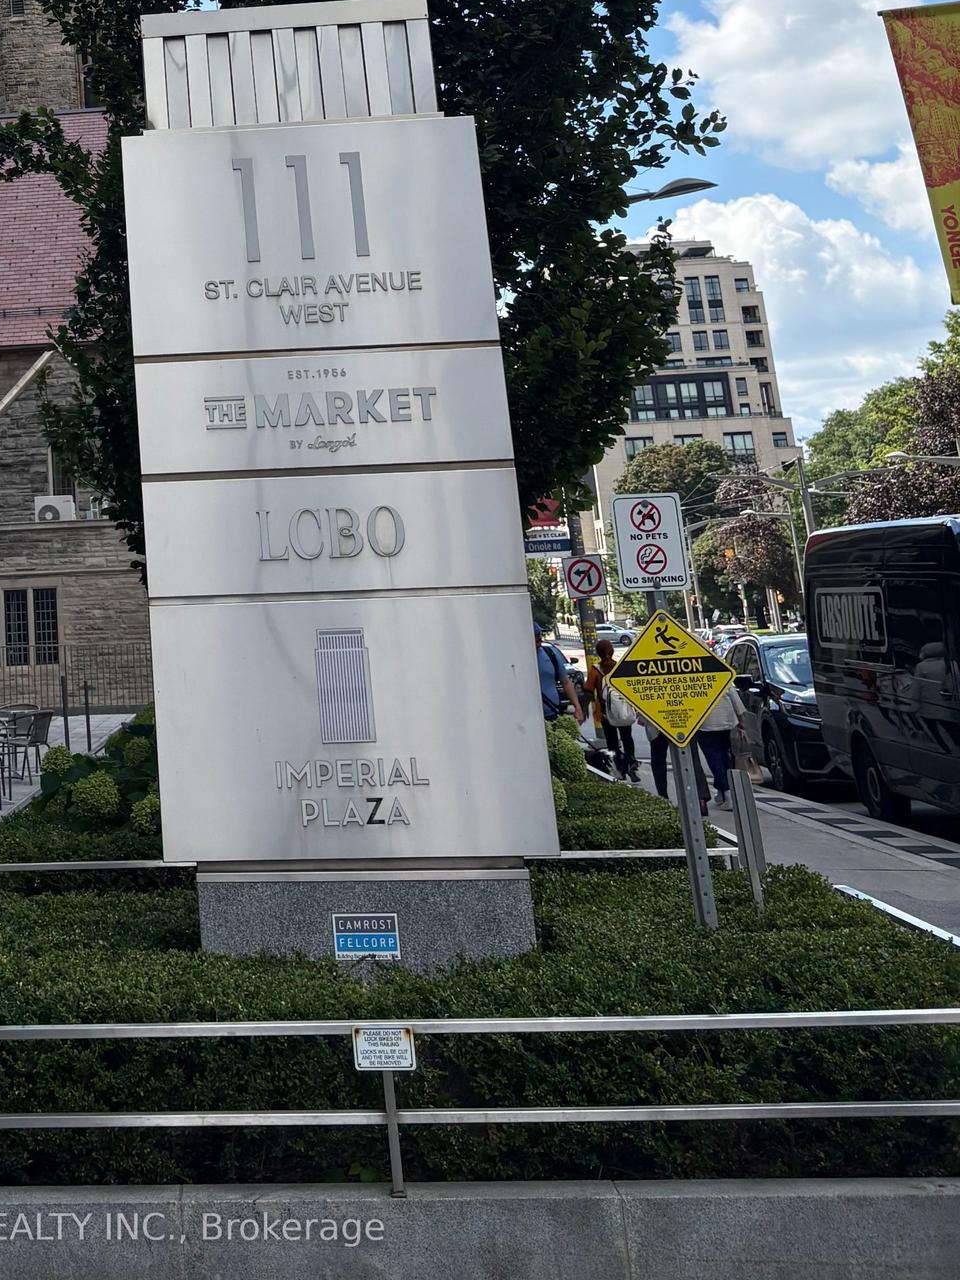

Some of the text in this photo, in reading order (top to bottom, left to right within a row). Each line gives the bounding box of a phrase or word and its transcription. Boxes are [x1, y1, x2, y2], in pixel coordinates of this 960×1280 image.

[231, 151, 370, 263] 111
[204, 270, 423, 301] ST. CLAIR AVENUE
[280, 302, 349, 324] WEST
[204, 387, 437, 428] THE MARKET
[290, 439, 303, 450] BY
[255, 504, 406, 562] LCBO
[528, 542, 552, 552] Oriole
[642, 575, 684, 584] SMOKING
[820, 594, 880, 641] ABSOLUTE
[636, 658, 703, 675] CAUTION
[626, 679, 660, 687] SURFACE
[662, 677, 688, 685] AREAS
[690, 675, 705, 683] MAY
[633, 683, 713, 694] SLIPPERY OR UNEVEN
[640, 690, 708, 701] USE AT YOUR OWN
[666, 699, 684, 707] RISK
[274, 756, 431, 790] IMPERIAL
[300, 796, 411, 827] PLAZA
[338, 919, 392, 930] CAMROST
